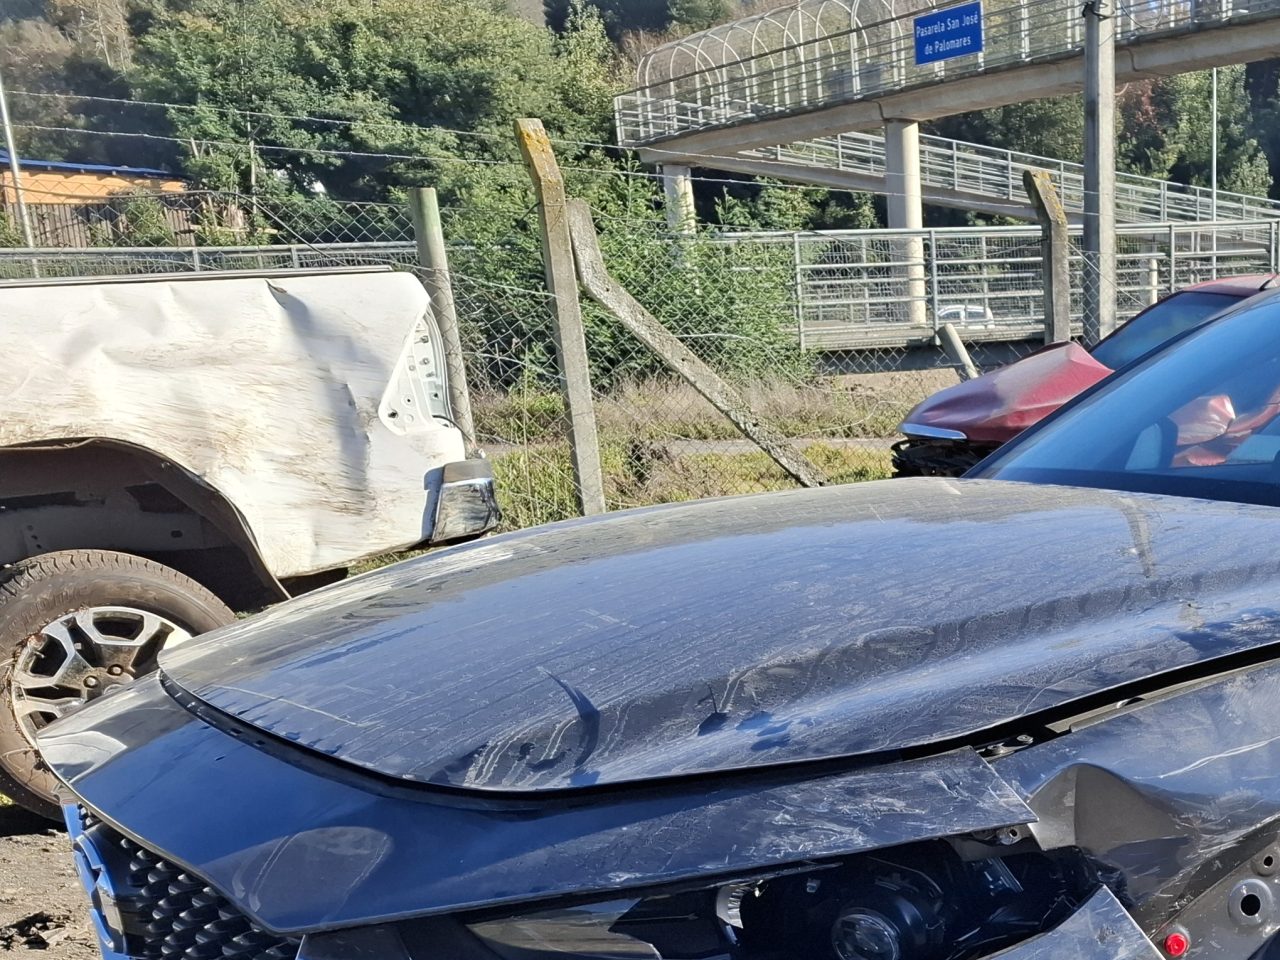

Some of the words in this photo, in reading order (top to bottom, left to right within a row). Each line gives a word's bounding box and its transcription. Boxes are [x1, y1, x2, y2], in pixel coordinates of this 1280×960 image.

[916, 21, 945, 38] Pasarela
[947, 17, 960, 31] San
[962, 11, 978, 26] José
[924, 43, 933, 55] de
[934, 36, 971, 53] Palomares
